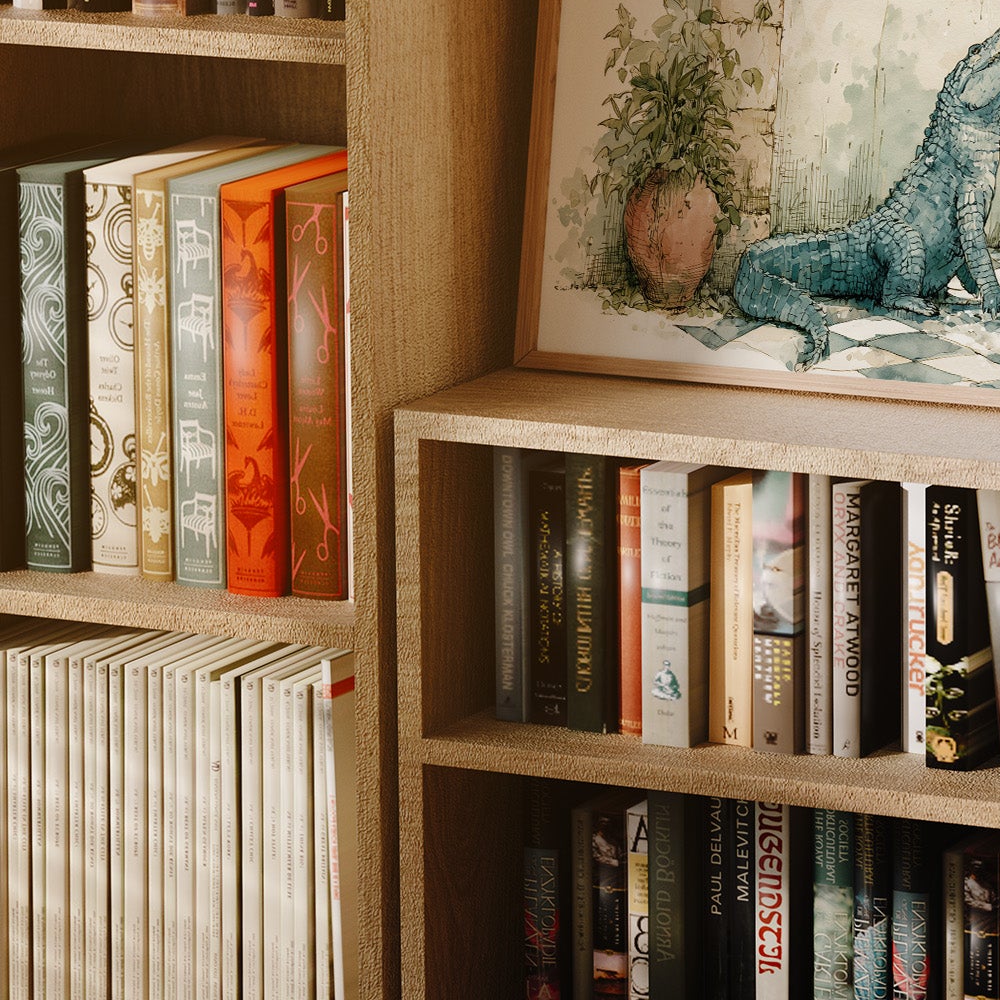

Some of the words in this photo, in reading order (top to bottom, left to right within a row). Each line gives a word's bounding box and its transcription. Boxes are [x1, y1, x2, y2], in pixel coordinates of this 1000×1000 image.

[501, 454, 515, 528] DOWNTOWN
[833, 491, 846, 546] ORYX
[502, 530, 515, 558] OWL
[833, 550, 846, 597] AND
[845, 492, 860, 607] MARGARET
[502, 562, 515, 608] CHUCK
[502, 609, 515, 690] KLOSTERMAN
[833, 600, 846, 670] CRAKE
[845, 611, 859, 697] ATWOOD
[711, 873, 724, 917] PAUL
